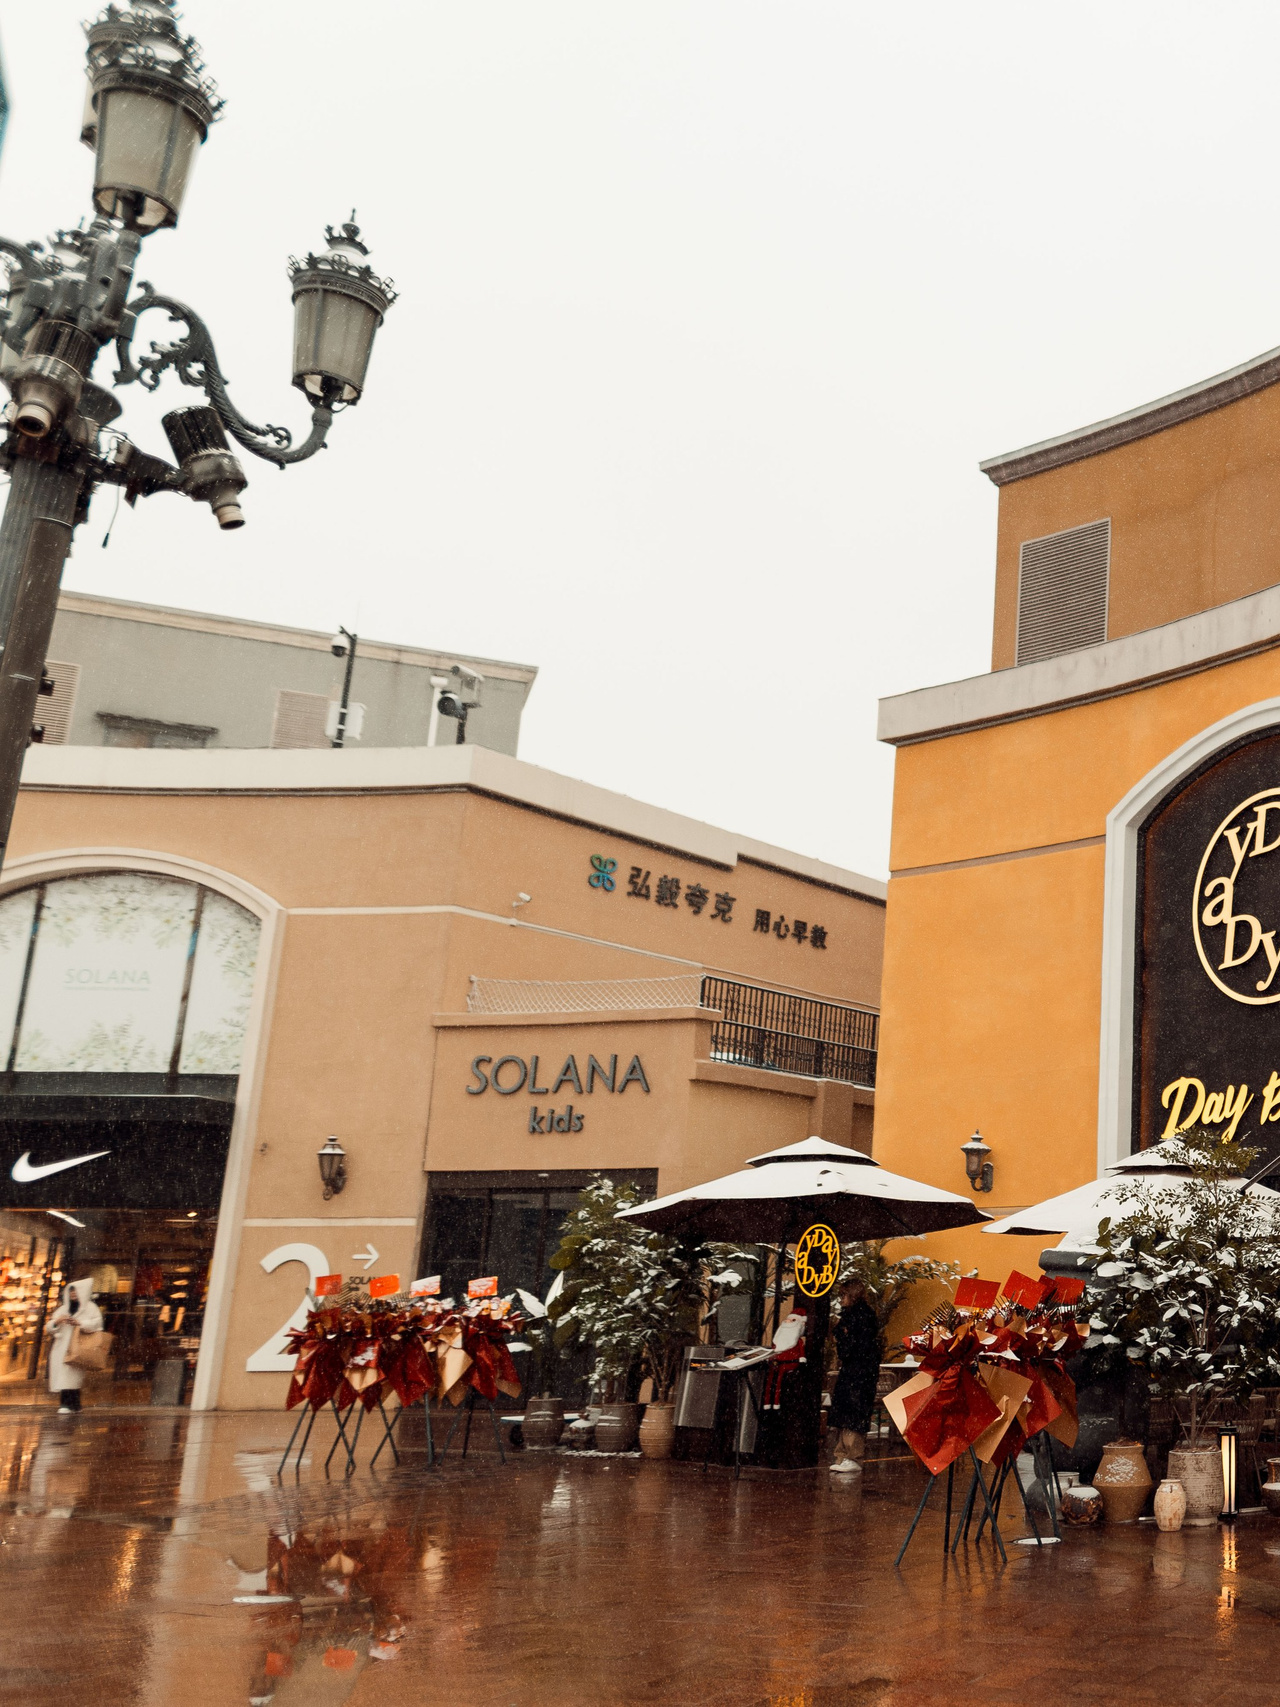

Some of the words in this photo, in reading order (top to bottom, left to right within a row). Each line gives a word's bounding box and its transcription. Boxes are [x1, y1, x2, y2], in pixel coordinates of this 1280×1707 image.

[753, 909, 828, 950] 用心早教
[63, 968, 152, 985] SOLANA
[466, 1054, 651, 1095] SOLANA
[528, 1105, 584, 1134] kids
[1160, 1076, 1254, 1144] Day
[246, 1243, 331, 1371] 2
